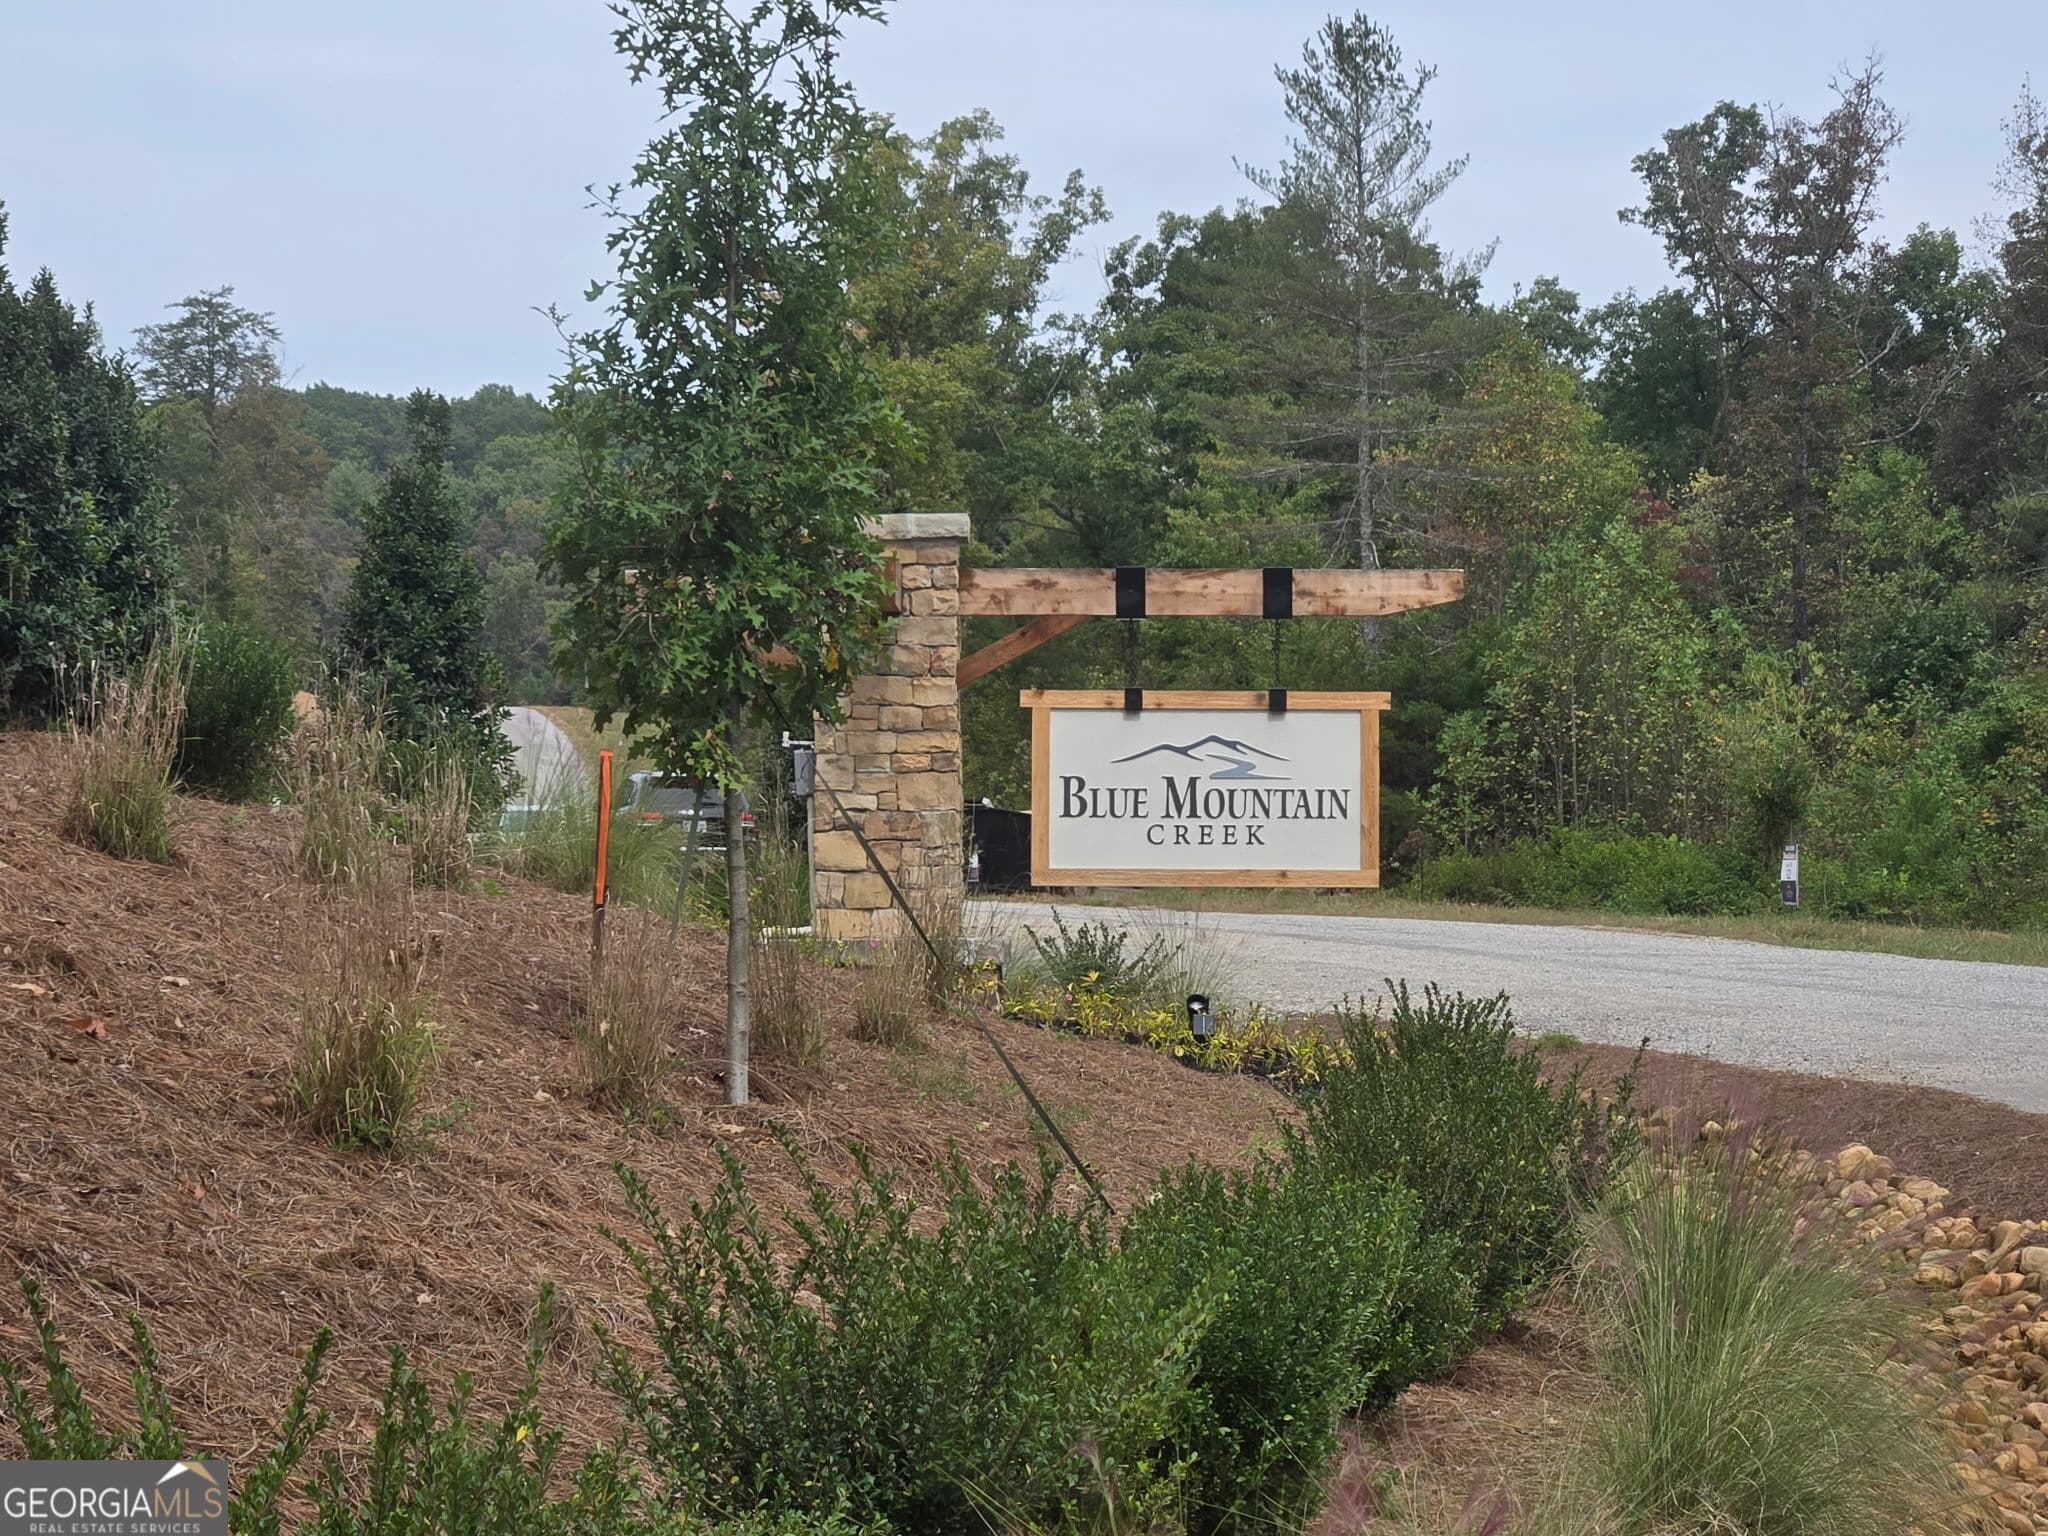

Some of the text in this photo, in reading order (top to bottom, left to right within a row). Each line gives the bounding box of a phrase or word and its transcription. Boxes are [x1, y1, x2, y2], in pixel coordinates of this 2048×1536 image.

[1059, 775, 1351, 819] BLUE MOUNTAIN
[1146, 824, 1265, 845] CREEK
